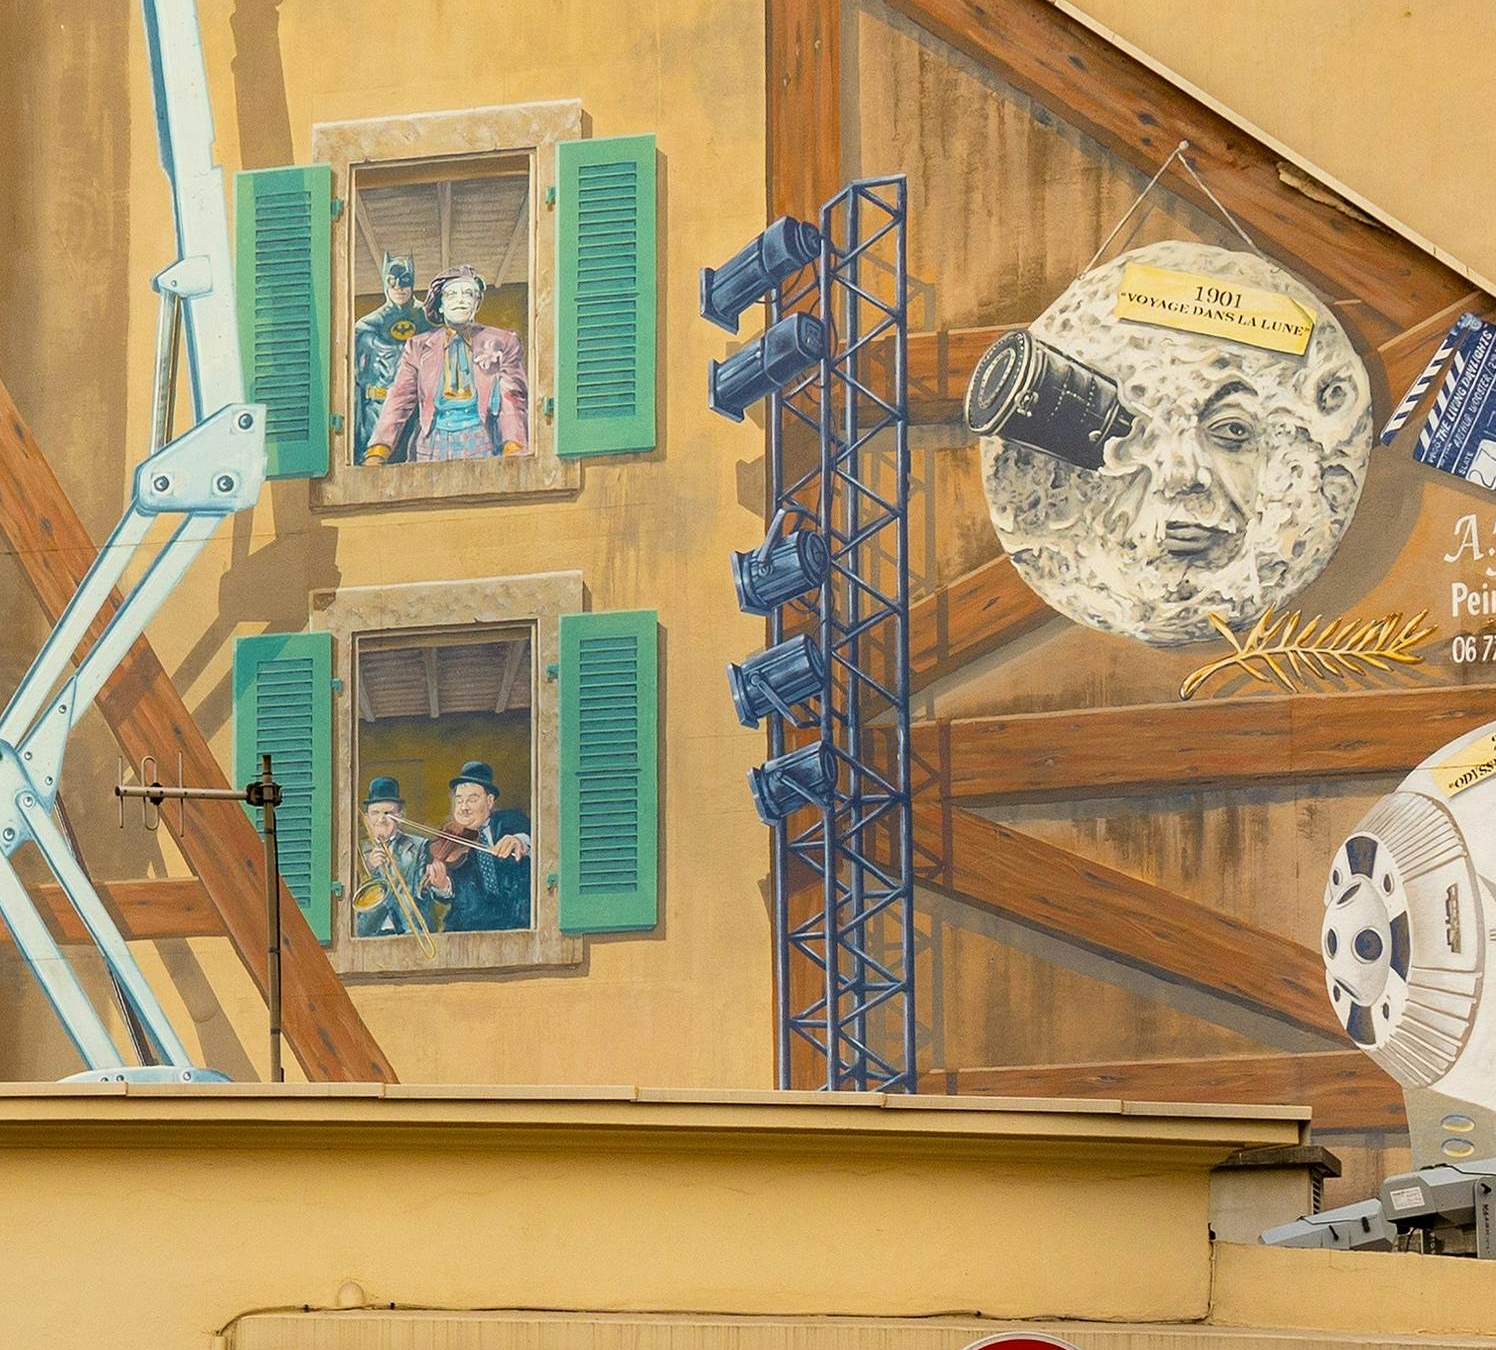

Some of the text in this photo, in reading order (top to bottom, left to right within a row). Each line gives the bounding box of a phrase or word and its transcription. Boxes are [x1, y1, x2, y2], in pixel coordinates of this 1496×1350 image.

[1194, 285, 1243, 309] 1901
[1192, 307, 1235, 322] DANS
[1237, 314, 1257, 328] LA
[1438, 420, 1452, 442] THE
[1448, 388, 1467, 421] LIVING
[1452, 635, 1477, 664] 06
